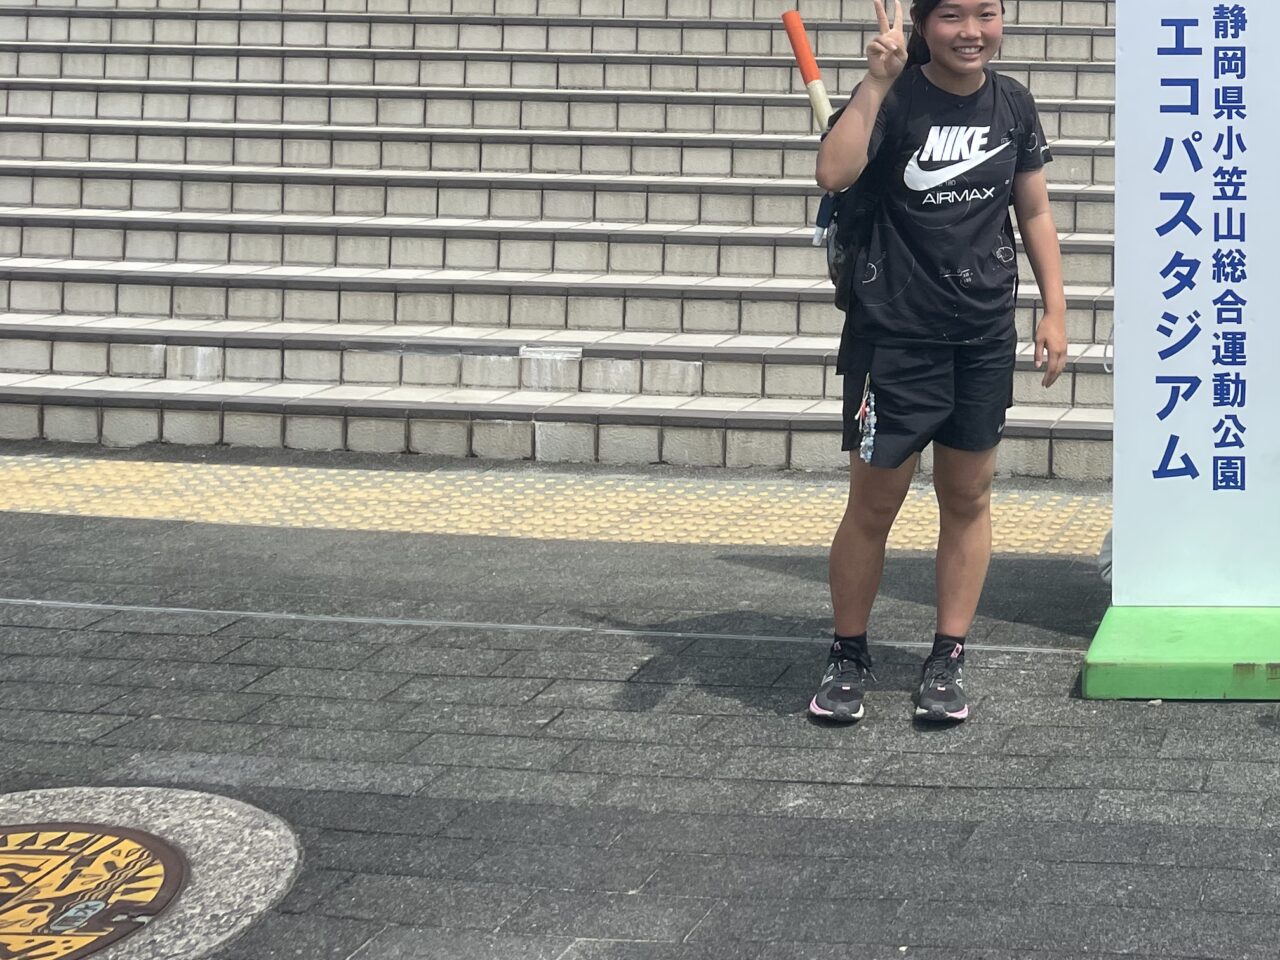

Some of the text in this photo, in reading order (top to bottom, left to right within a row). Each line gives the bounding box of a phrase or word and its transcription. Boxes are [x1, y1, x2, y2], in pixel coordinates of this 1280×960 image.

[919, 125, 991, 162] NIKE
[922, 187, 995, 205] AIRMAX
[1152, 18, 1203, 480] エコパスタジアム
[1212, 3, 1248, 491] 静岡県小笠山総合運動公園
